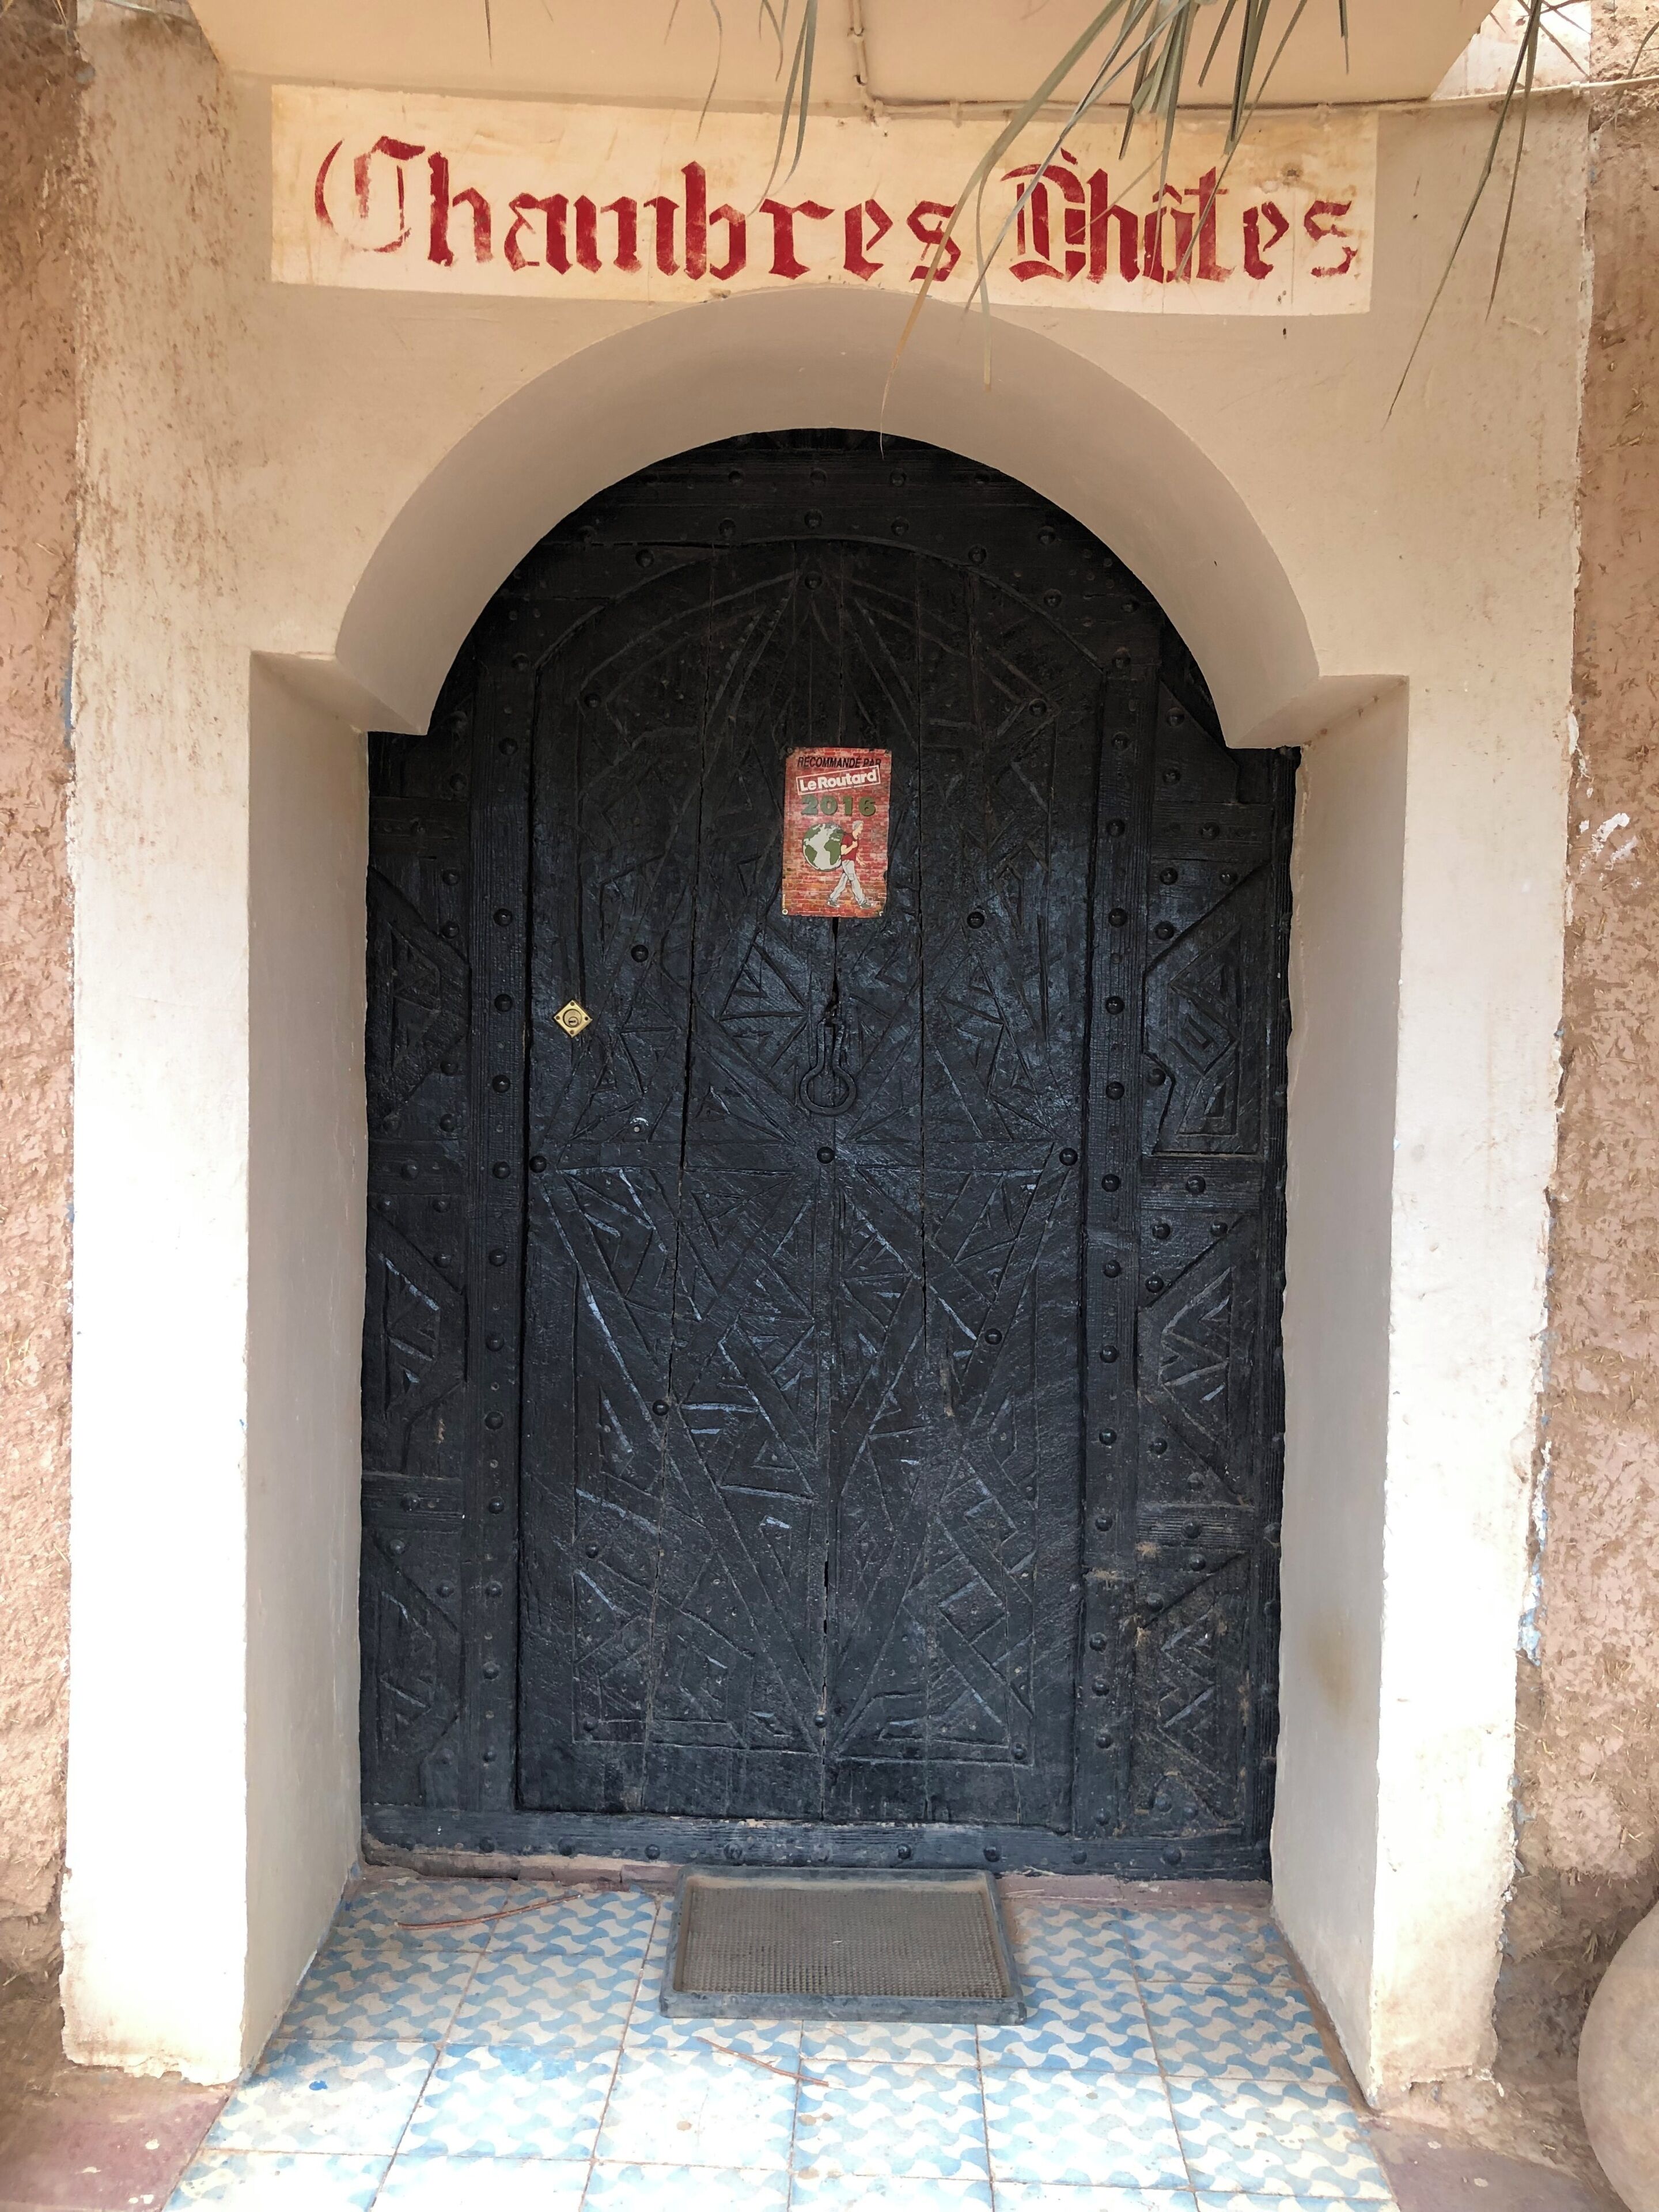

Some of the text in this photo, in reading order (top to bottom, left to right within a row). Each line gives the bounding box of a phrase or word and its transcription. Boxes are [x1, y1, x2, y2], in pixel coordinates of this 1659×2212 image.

[315, 135, 961, 282] Chambres
[863, 758, 881, 768] PAR
[800, 769, 877, 791] Le Routard
[801, 795, 876, 816] 2016
